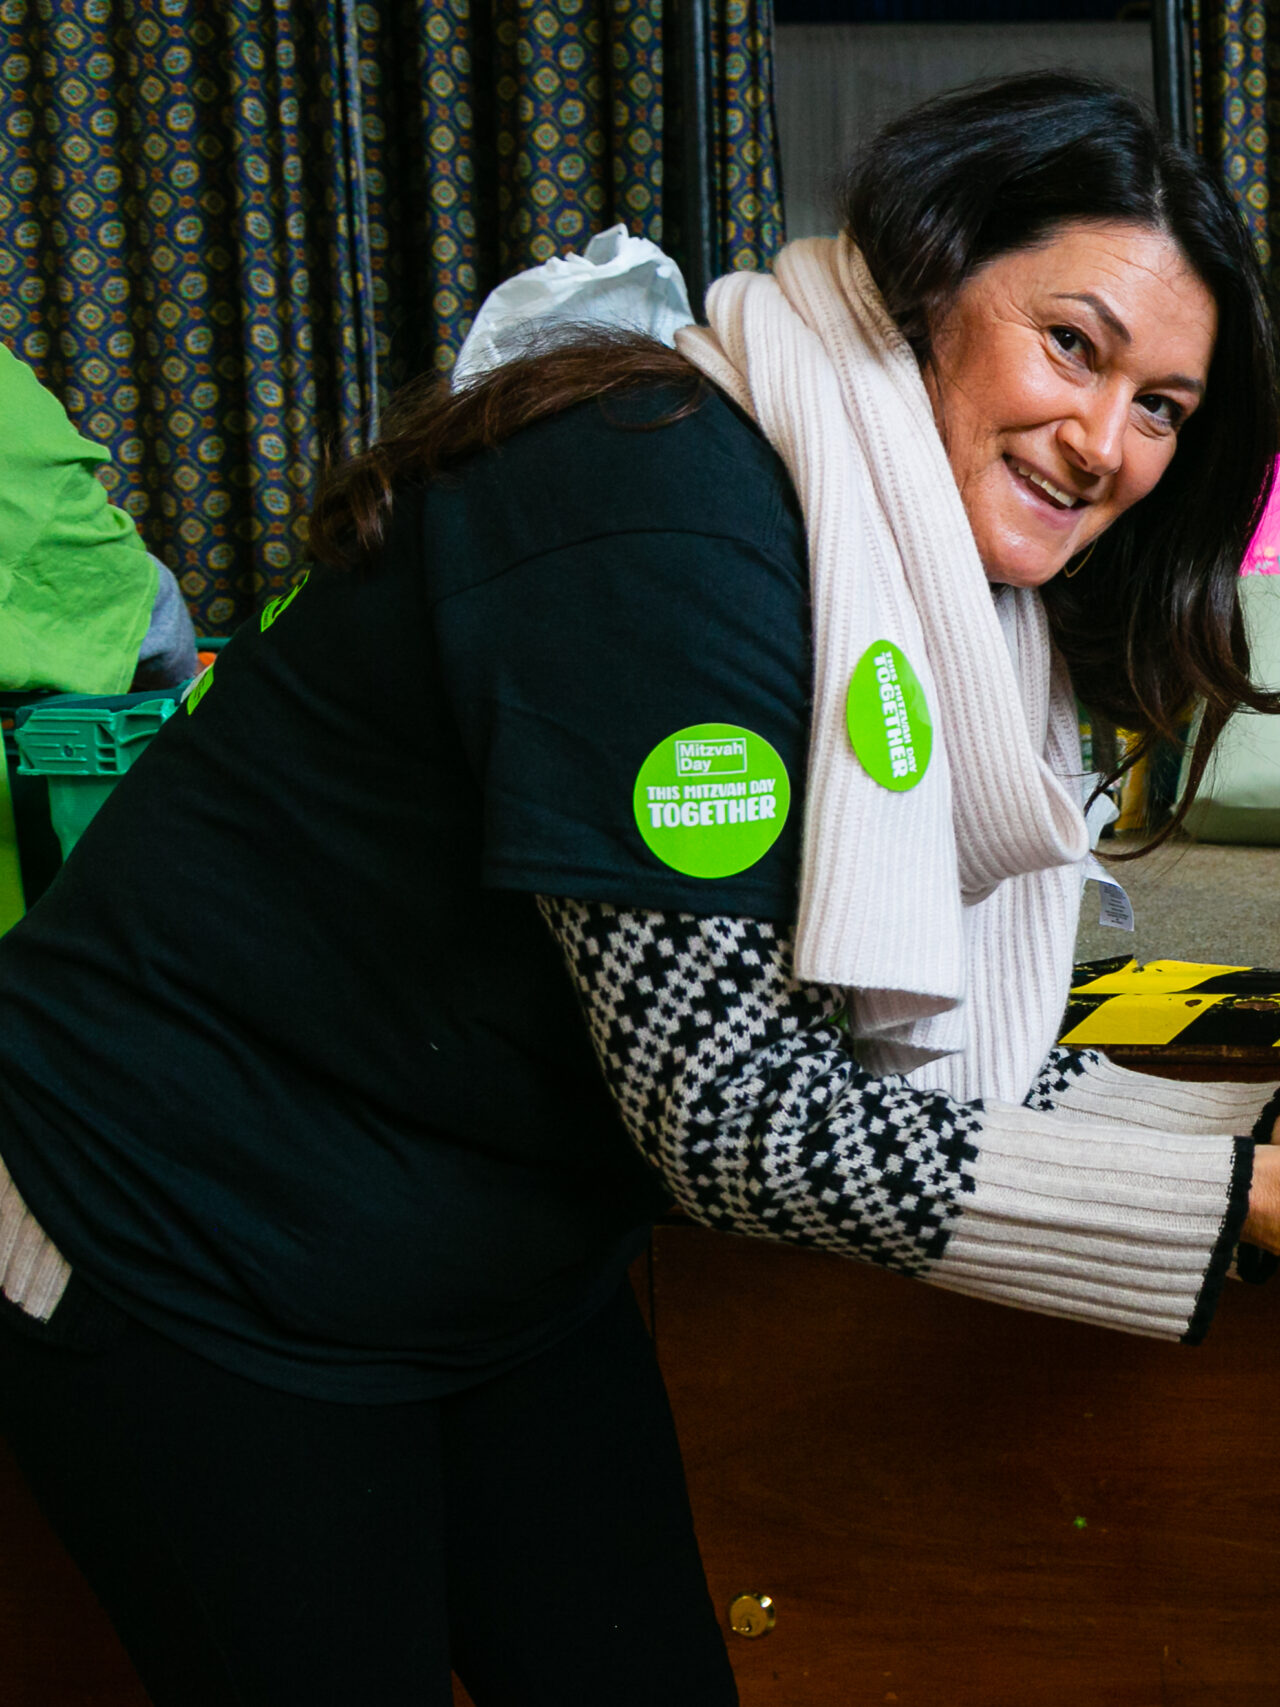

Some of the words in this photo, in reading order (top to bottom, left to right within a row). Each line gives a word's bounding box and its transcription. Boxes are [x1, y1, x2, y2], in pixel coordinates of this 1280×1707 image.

[874, 653, 909, 778] TOGETHER
[885, 651, 898, 682] THIS
[894, 684, 912, 744] MITZVAH
[906, 747, 917, 773] DAY
[680, 742, 743, 757] Mitzvah
[680, 758, 711, 773] Day
[646, 786, 680, 801] THIS
[683, 782, 747, 799] MITZVAH
[749, 779, 776, 795] DAY
[647, 795, 776, 828] TOGETHER
